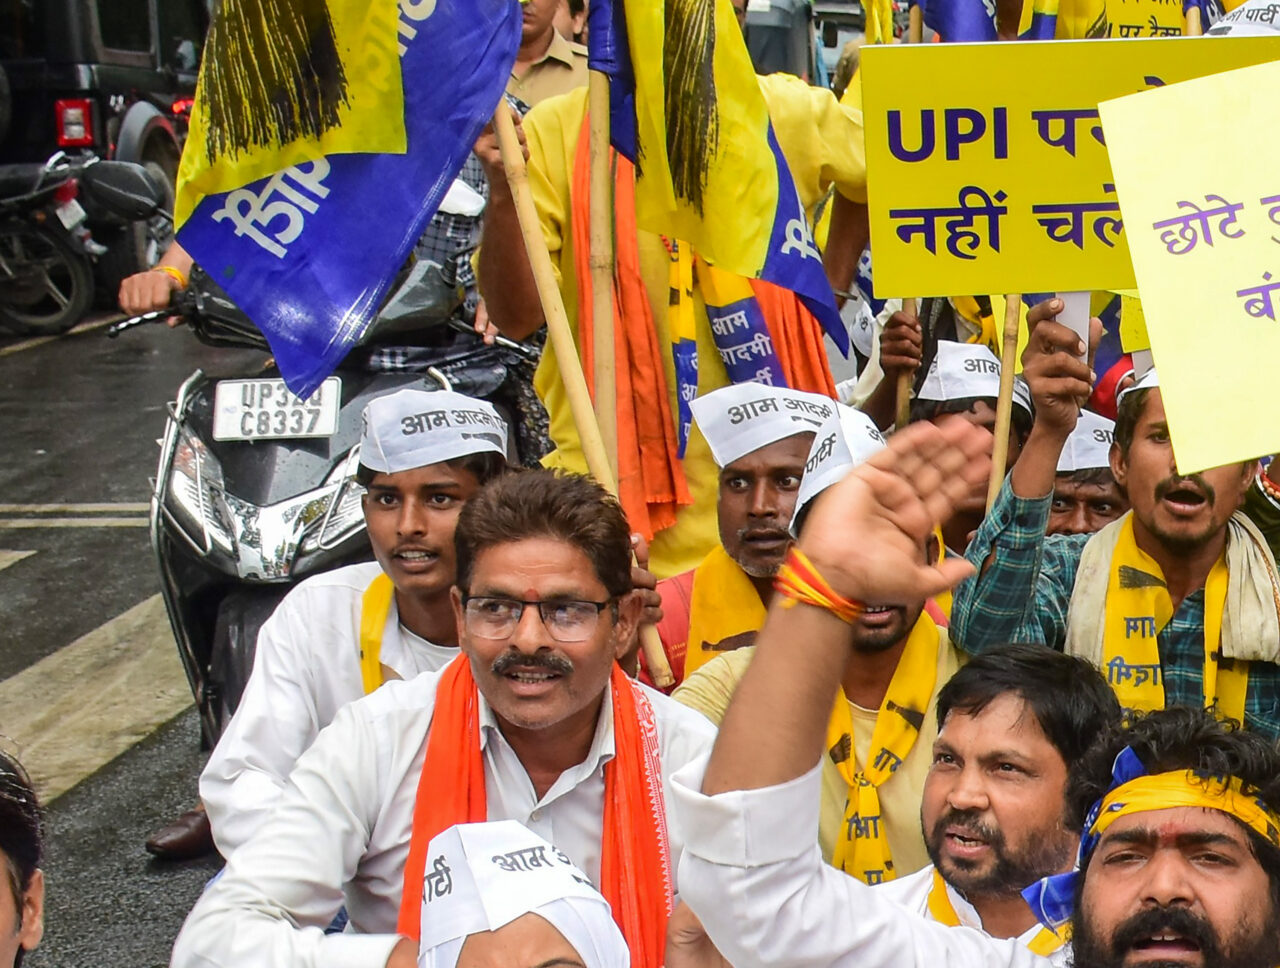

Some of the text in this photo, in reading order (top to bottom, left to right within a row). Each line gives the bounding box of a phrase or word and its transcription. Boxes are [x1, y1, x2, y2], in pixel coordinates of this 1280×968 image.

[887, 107, 1008, 163] UPI
[889, 186, 1008, 260] नहीं
[1152, 194, 1246, 256] छोटे
[240, 408, 322, 436] C8337
[401, 409, 450, 436] आम
[727, 397, 780, 425] आम
